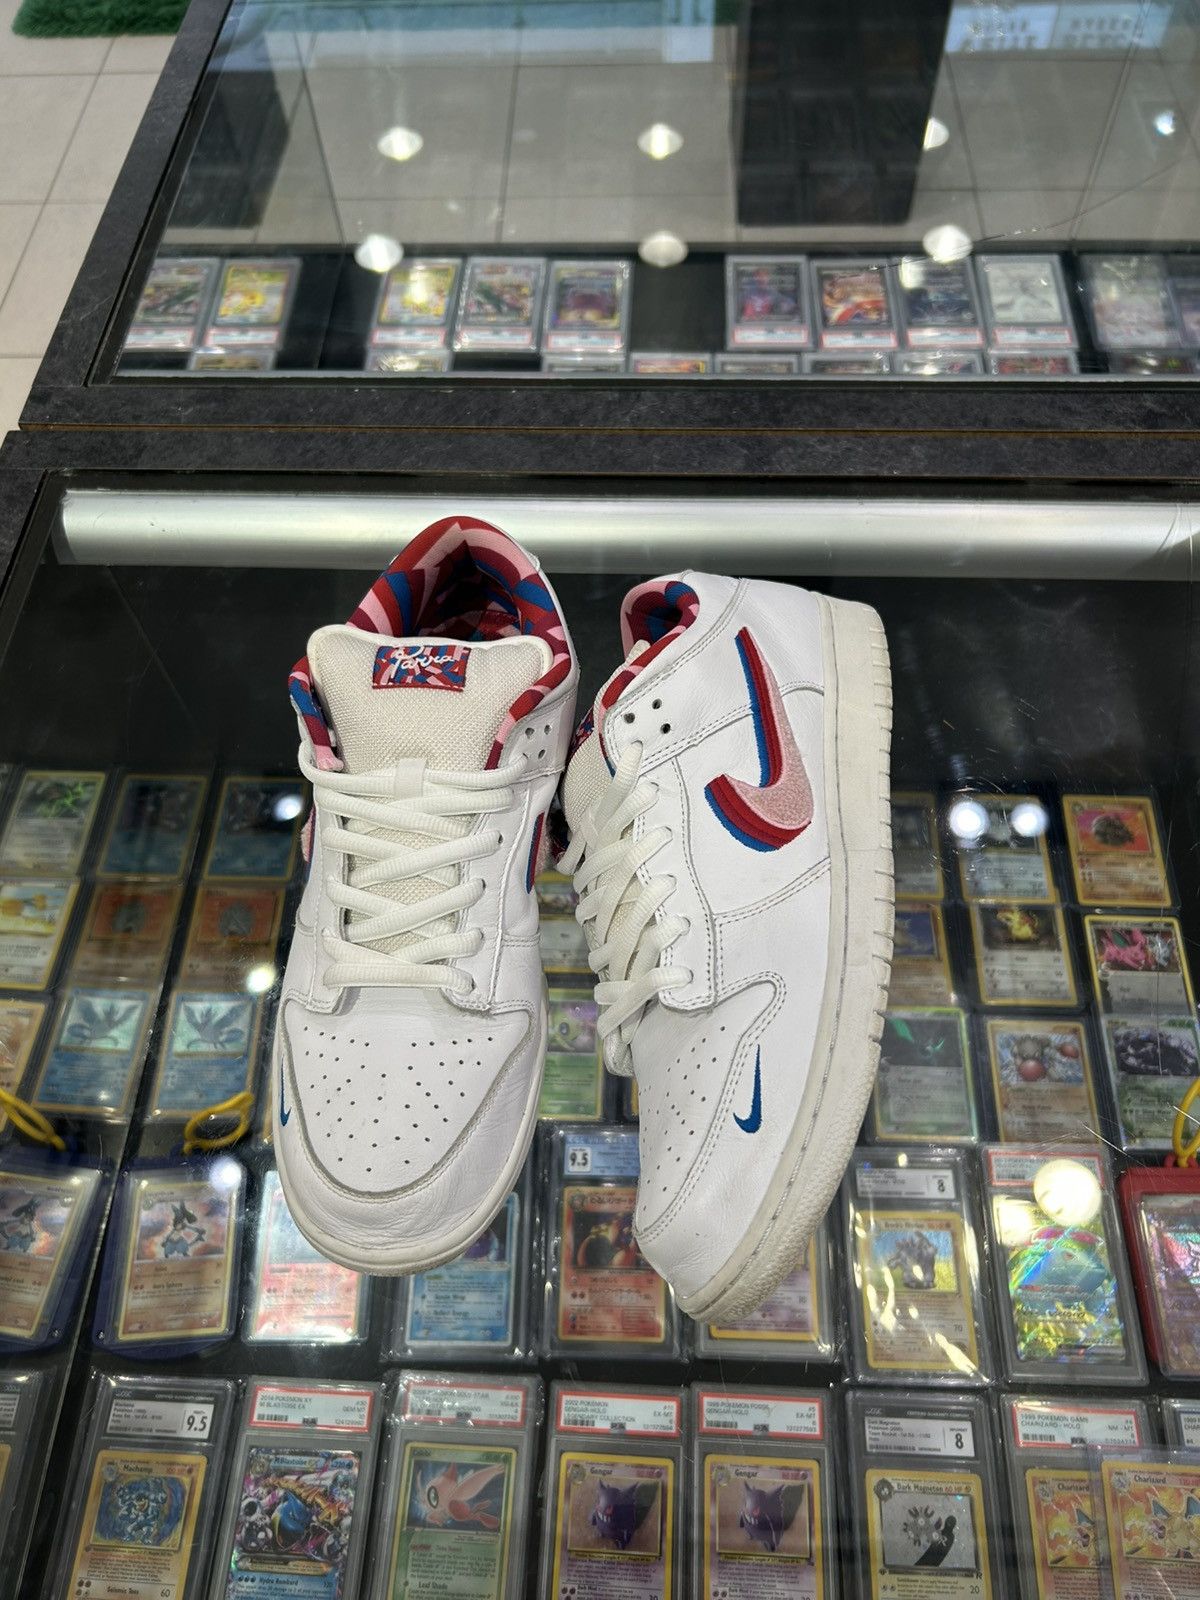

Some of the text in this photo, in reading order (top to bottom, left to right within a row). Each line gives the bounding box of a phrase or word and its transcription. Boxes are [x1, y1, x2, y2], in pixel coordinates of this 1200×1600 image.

[390, 645, 455, 680] Parra
[569, 1151, 588, 1167] 9.5
[186, 1414, 208, 1432] 9.5
[1021, 1413, 1089, 1424] 1999 POKEMON GAME
[1021, 1420, 1059, 1429] CHARIZARD
[1063, 1422, 1081, 1430] HOLO
[955, 1432, 964, 1450] 8
[122, 1464, 153, 1475] Machamp
[589, 1466, 613, 1476] Gengar
[734, 1468, 758, 1479] Gengar
[1133, 1473, 1167, 1485] Charizard
[896, 1482, 912, 1491] Dark
[913, 1483, 944, 1494] Magneton
[1057, 1481, 1090, 1492] Charizard
[160, 1588, 171, 1598] 60
[970, 1585, 980, 1594] 20
